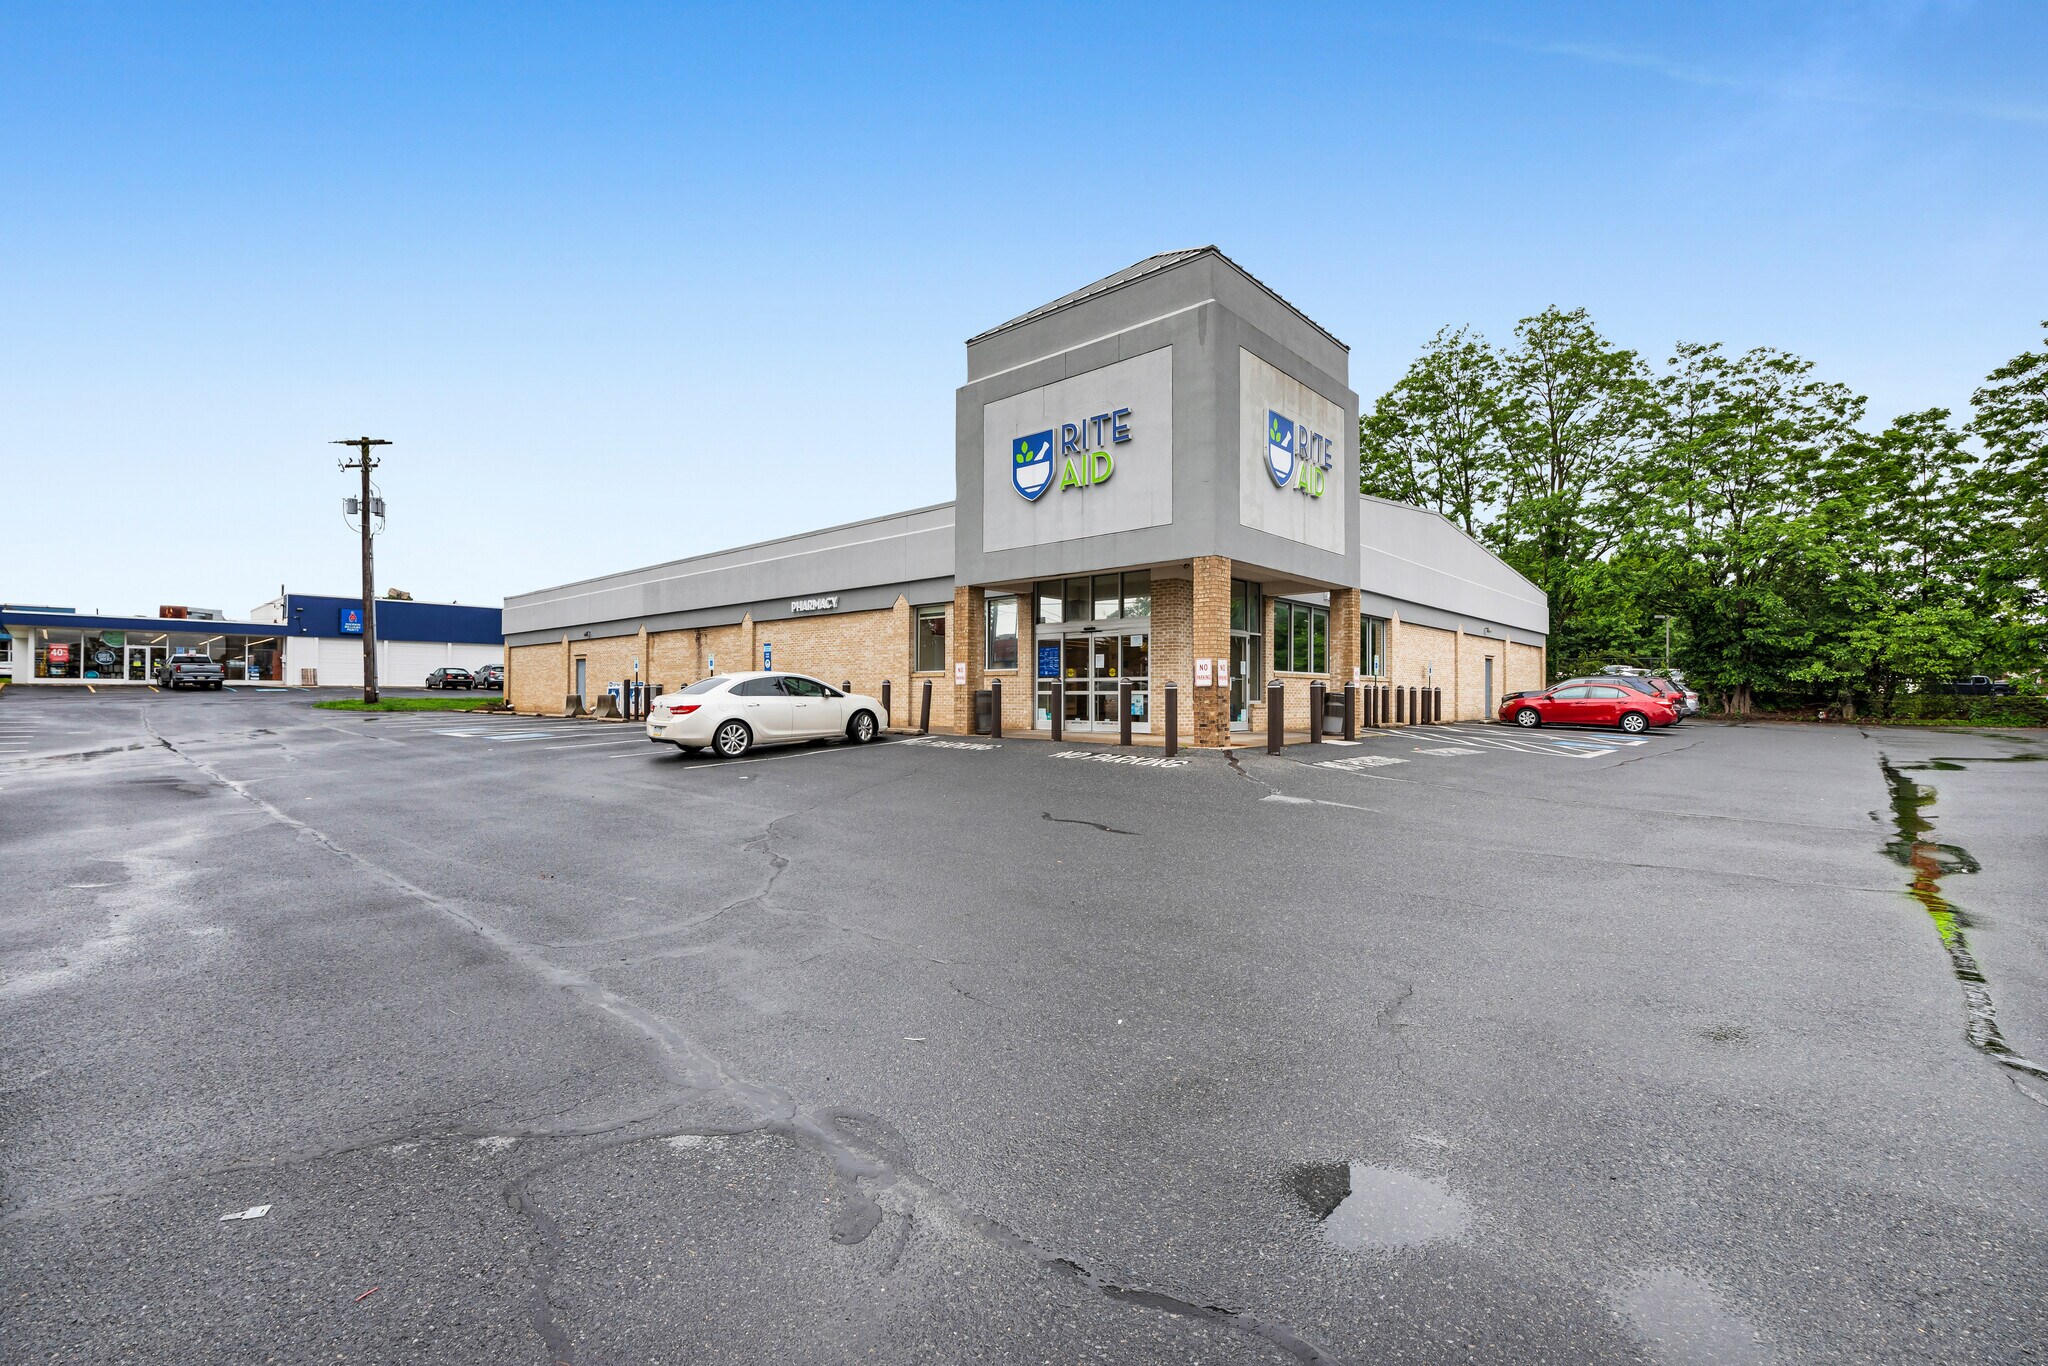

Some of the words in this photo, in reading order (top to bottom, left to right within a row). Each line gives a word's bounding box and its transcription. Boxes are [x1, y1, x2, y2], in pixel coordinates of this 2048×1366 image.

[1061, 407, 1132, 456] RITE
[1297, 424, 1333, 470] RITE
[1060, 451, 1114, 491] AID
[1294, 461, 1325, 497] AID
[791, 596, 838, 612] PHARMACY
[1199, 663, 1209, 671] NO
[1048, 750, 1092, 759] NO
[1081, 753, 1190, 768] PARKING
